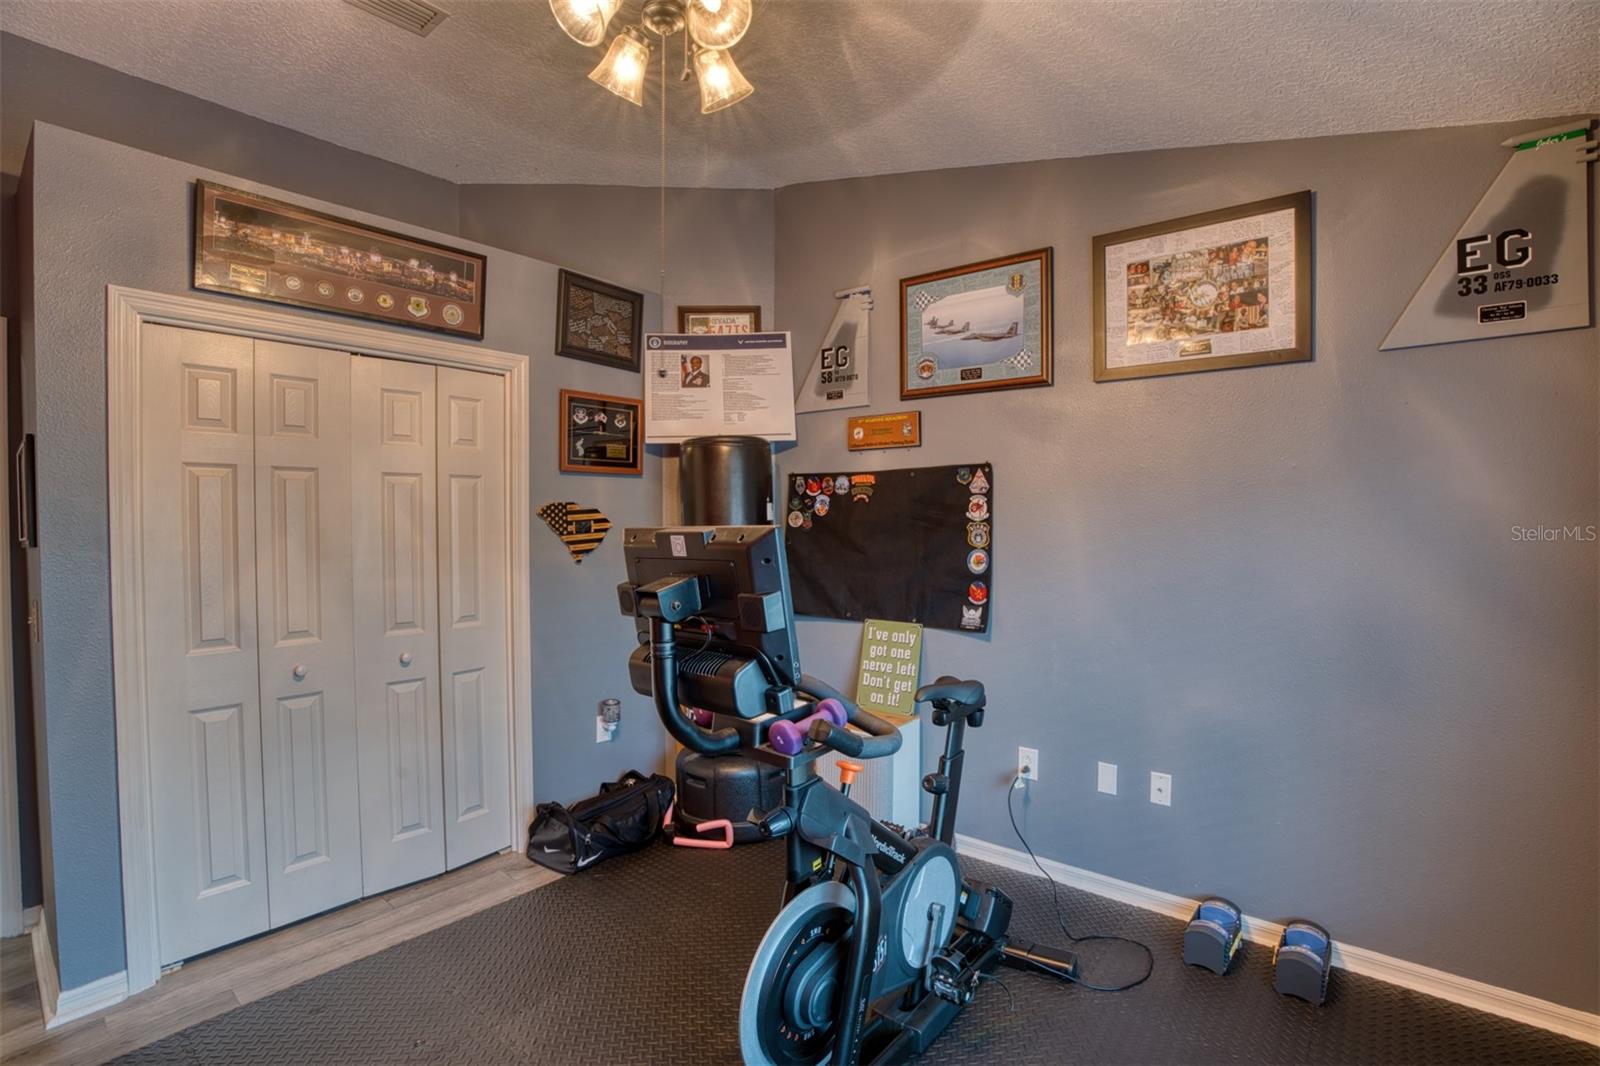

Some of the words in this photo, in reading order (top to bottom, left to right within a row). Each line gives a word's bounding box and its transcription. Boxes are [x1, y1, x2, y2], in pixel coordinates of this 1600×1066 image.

[1457, 229, 1532, 276] EG
[1493, 270, 1511, 280] OSS
[1457, 275, 1488, 297] 33
[1494, 274, 1559, 293] AF79-0033
[821, 345, 850, 370] EG
[821, 371, 833, 384] 58
[868, 626, 888, 641] I've
[891, 630, 916, 647] only
[870, 645, 887, 658] got
[890, 647, 911, 659] one
[863, 660, 893, 673] nerve
[896, 661, 916, 676] left
[863, 672, 890, 689] Don't
[894, 680, 912, 693] get
[870, 692, 883, 704] on
[887, 692, 900, 706] it!
